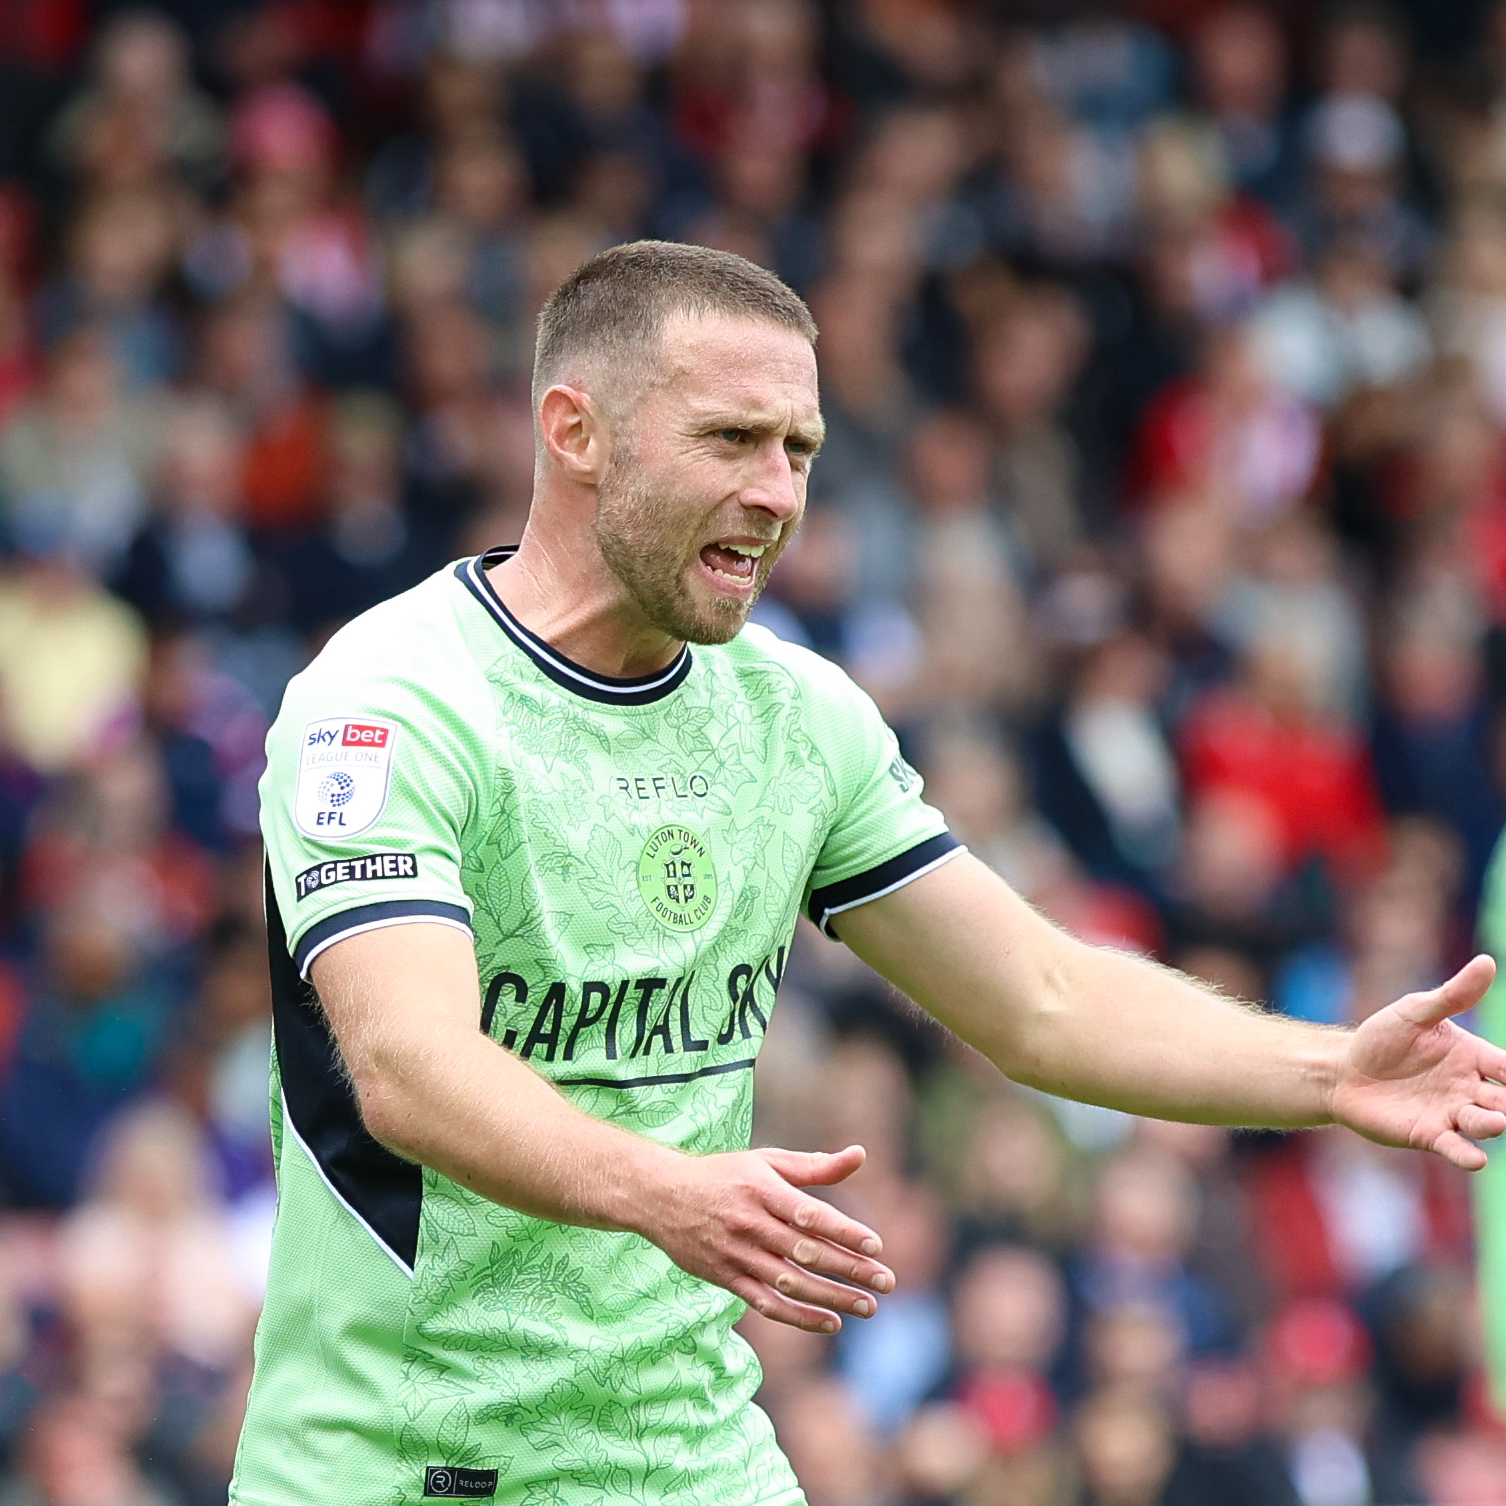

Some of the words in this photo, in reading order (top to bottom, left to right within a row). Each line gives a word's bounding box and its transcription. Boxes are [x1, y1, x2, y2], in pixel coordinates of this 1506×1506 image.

[307, 728, 340, 747] sky
[346, 725, 385, 744] bet
[305, 750, 351, 766] LEAGUE
[355, 751, 381, 763] ONE
[615, 775, 709, 799] REFLO
[316, 811, 347, 826] EFL
[645, 828, 675, 859] LUTON
[677, 828, 706, 858] TOWN
[297, 855, 414, 897] TOGETHER
[650, 896, 694, 925] FOOTBALL
[694, 895, 712, 920] CLUB
[480, 970, 709, 1062] CAPITAL
[458, 1480, 493, 1489] RELOOP
